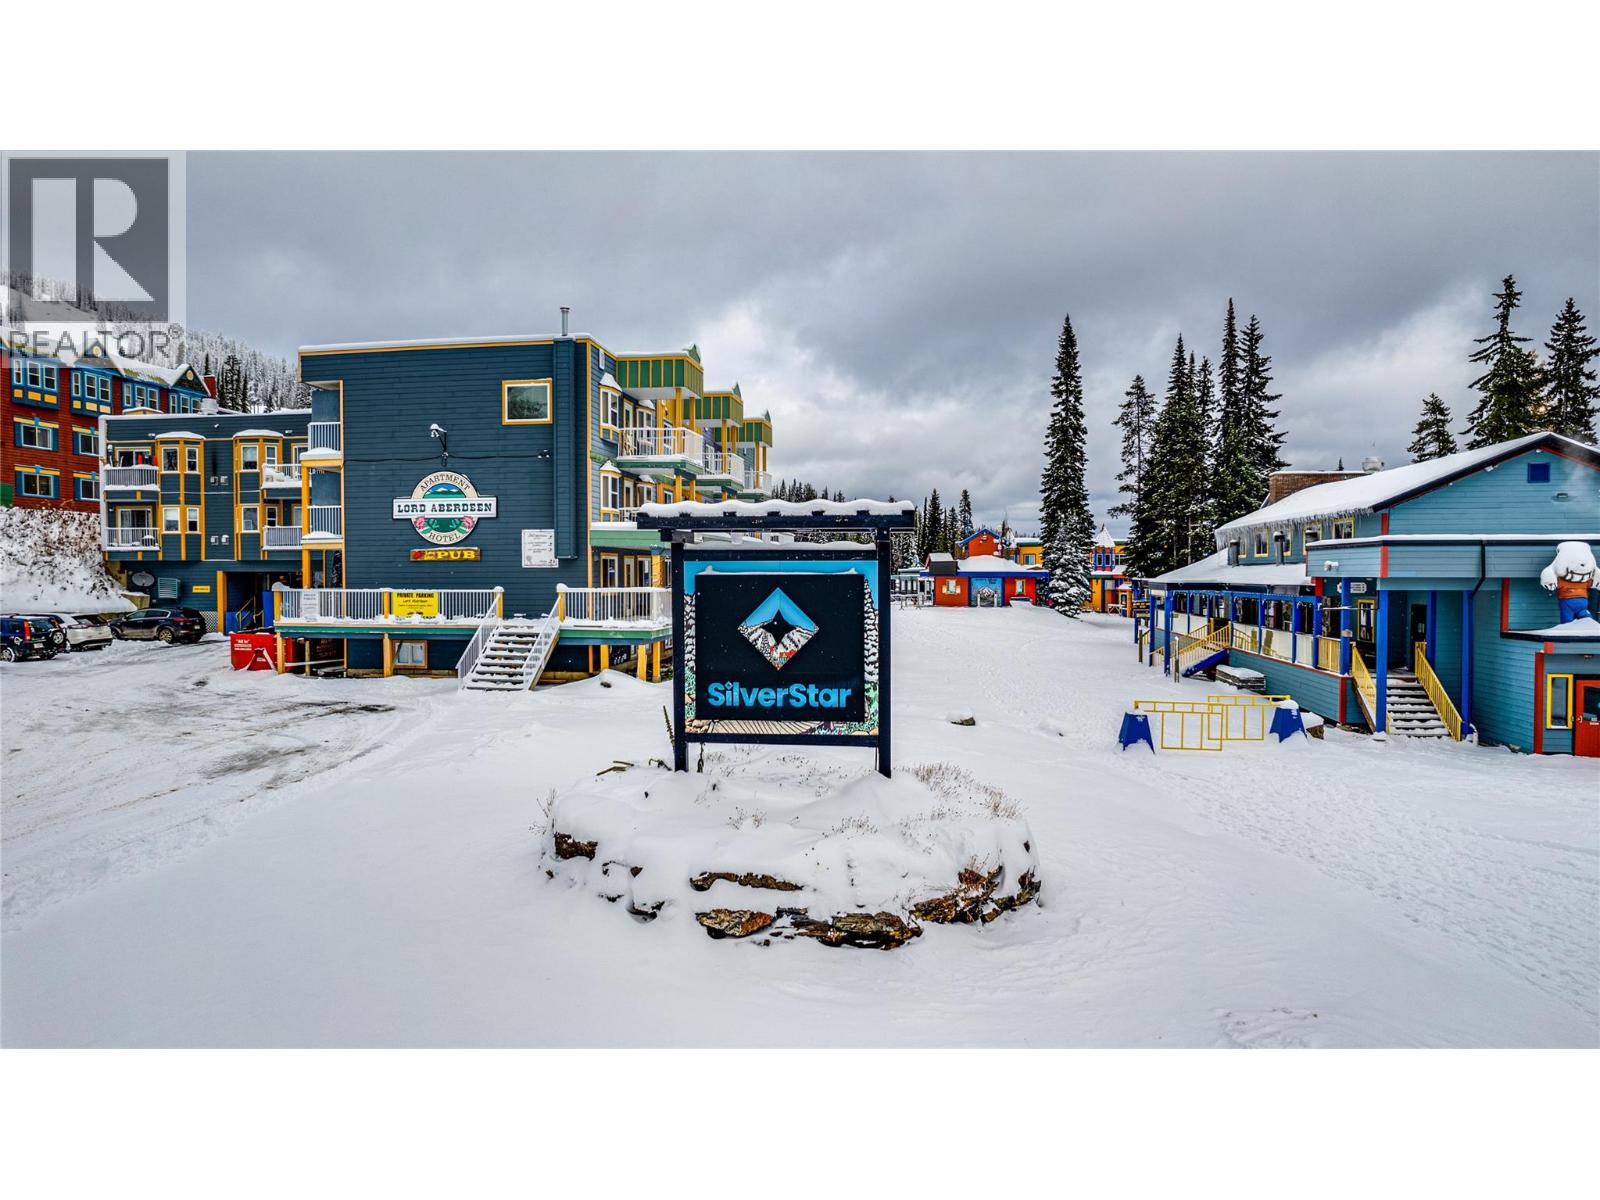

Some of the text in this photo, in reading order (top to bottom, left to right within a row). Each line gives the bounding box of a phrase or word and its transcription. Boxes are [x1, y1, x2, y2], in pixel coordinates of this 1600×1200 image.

[420, 474, 470, 491] APARTMENT
[397, 503, 492, 513] LORD ABERDEEN
[428, 532, 460, 542] HOTEL
[437, 550, 475, 559] PUB
[707, 681, 851, 708] SilverStar
